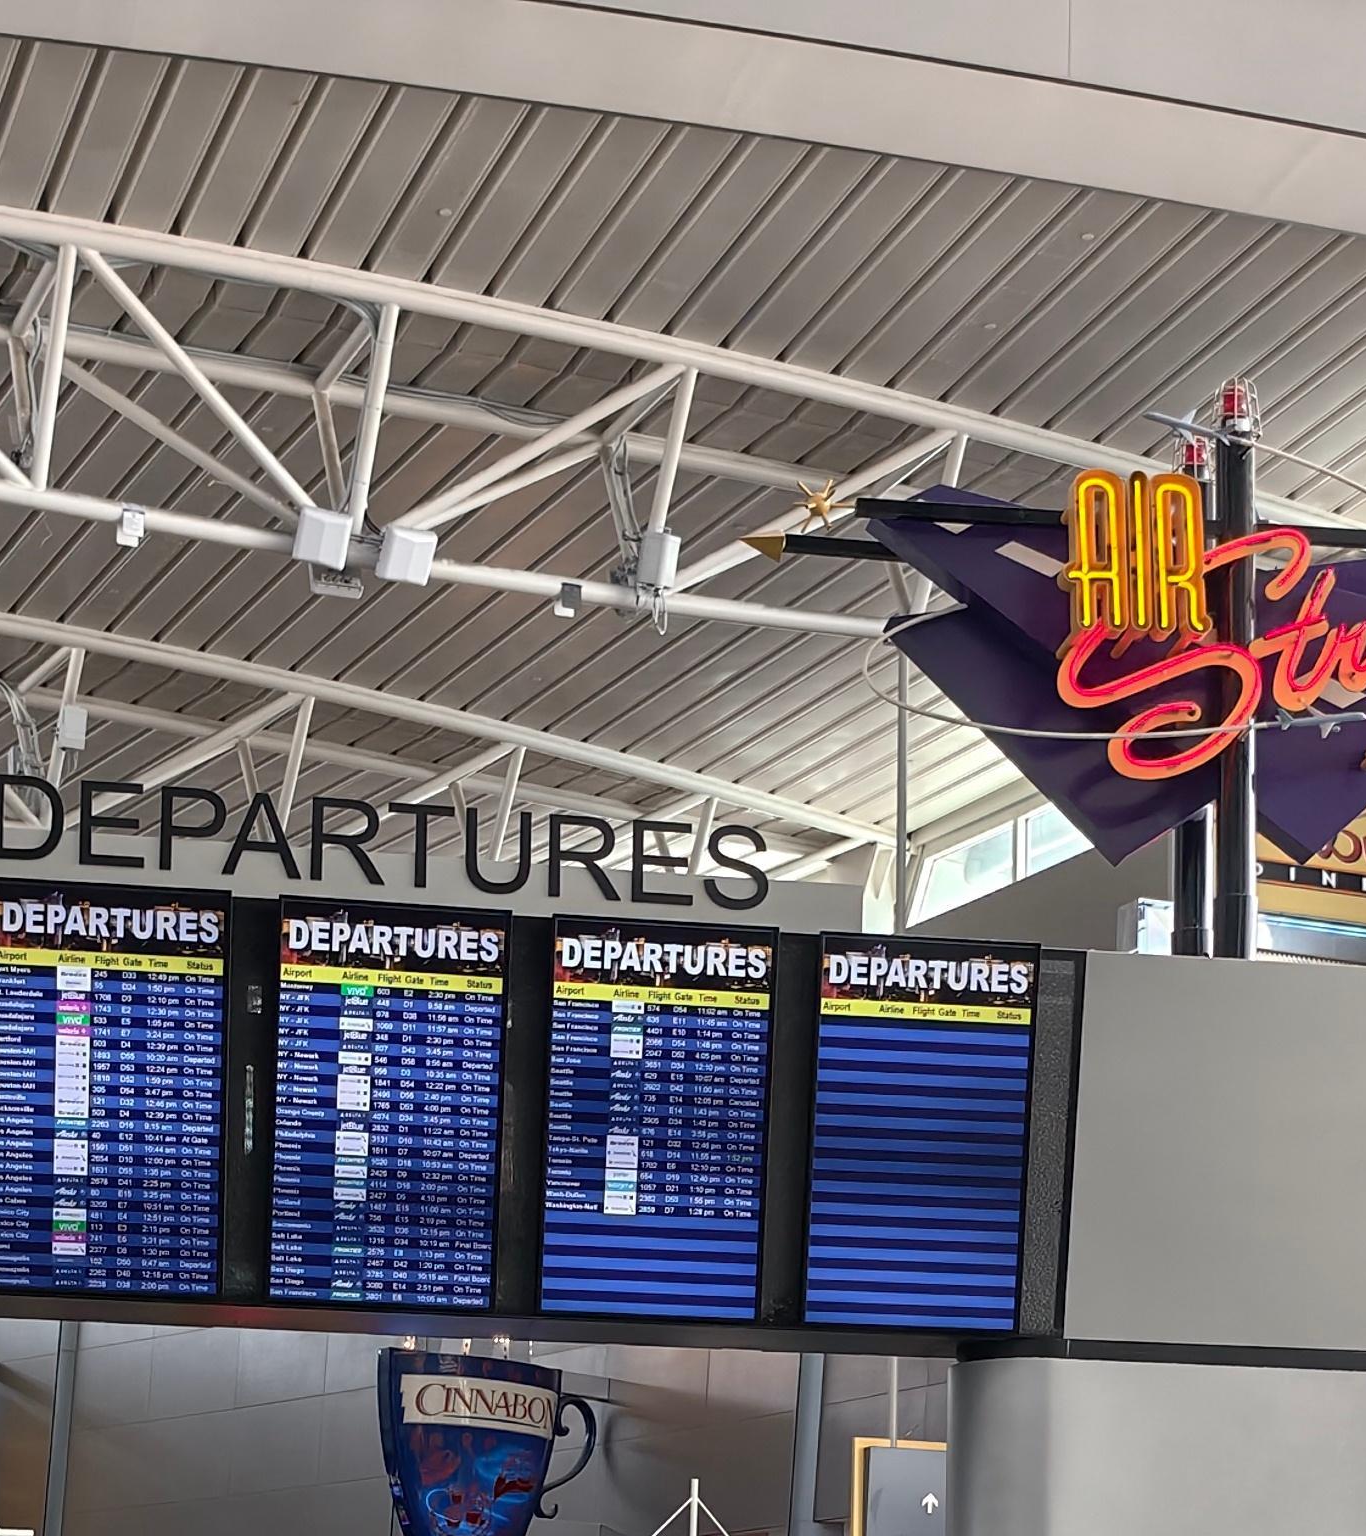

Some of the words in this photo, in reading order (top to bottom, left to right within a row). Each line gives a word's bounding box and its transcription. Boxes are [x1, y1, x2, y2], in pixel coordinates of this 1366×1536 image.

[1066, 468, 1208, 634] AIR
[2, 901, 219, 943] DEPARTURES
[289, 919, 499, 962] DEPARTURES
[58, 953, 86, 964] Airline
[95, 955, 119, 966] Flight
[123, 957, 142, 967] Gate
[148, 958, 168, 969] Time
[187, 961, 213, 971] Status
[562, 938, 767, 979] DEPARTURES
[829, 955, 1028, 994] DEPARTURES
[283, 968, 312, 979] Airport
[342, 971, 368, 982] Airline
[378, 974, 401, 985] Flight
[405, 975, 424, 985] Gate
[430, 977, 449, 986] Time
[467, 979, 493, 989] Status
[556, 985, 584, 996] Airport
[613, 989, 639, 999] Airline
[648, 991, 671, 1001] Flight
[674, 992, 693, 1002] Gate
[699, 994, 717, 1003] Time
[735, 995, 760, 1005] Status
[168, 999, 179, 1007] pm
[184, 999, 196, 1007] On
[198, 999, 214, 1008] Time
[823, 1002, 851, 1012] Airport
[879, 1004, 904, 1015] Airline
[913, 1006, 935, 1017] Flight
[939, 1008, 957, 1017] Gate
[963, 1009, 980, 1018] Time
[997, 1011, 1022, 1020] Status
[415, 1383, 554, 1430] CINNABON
